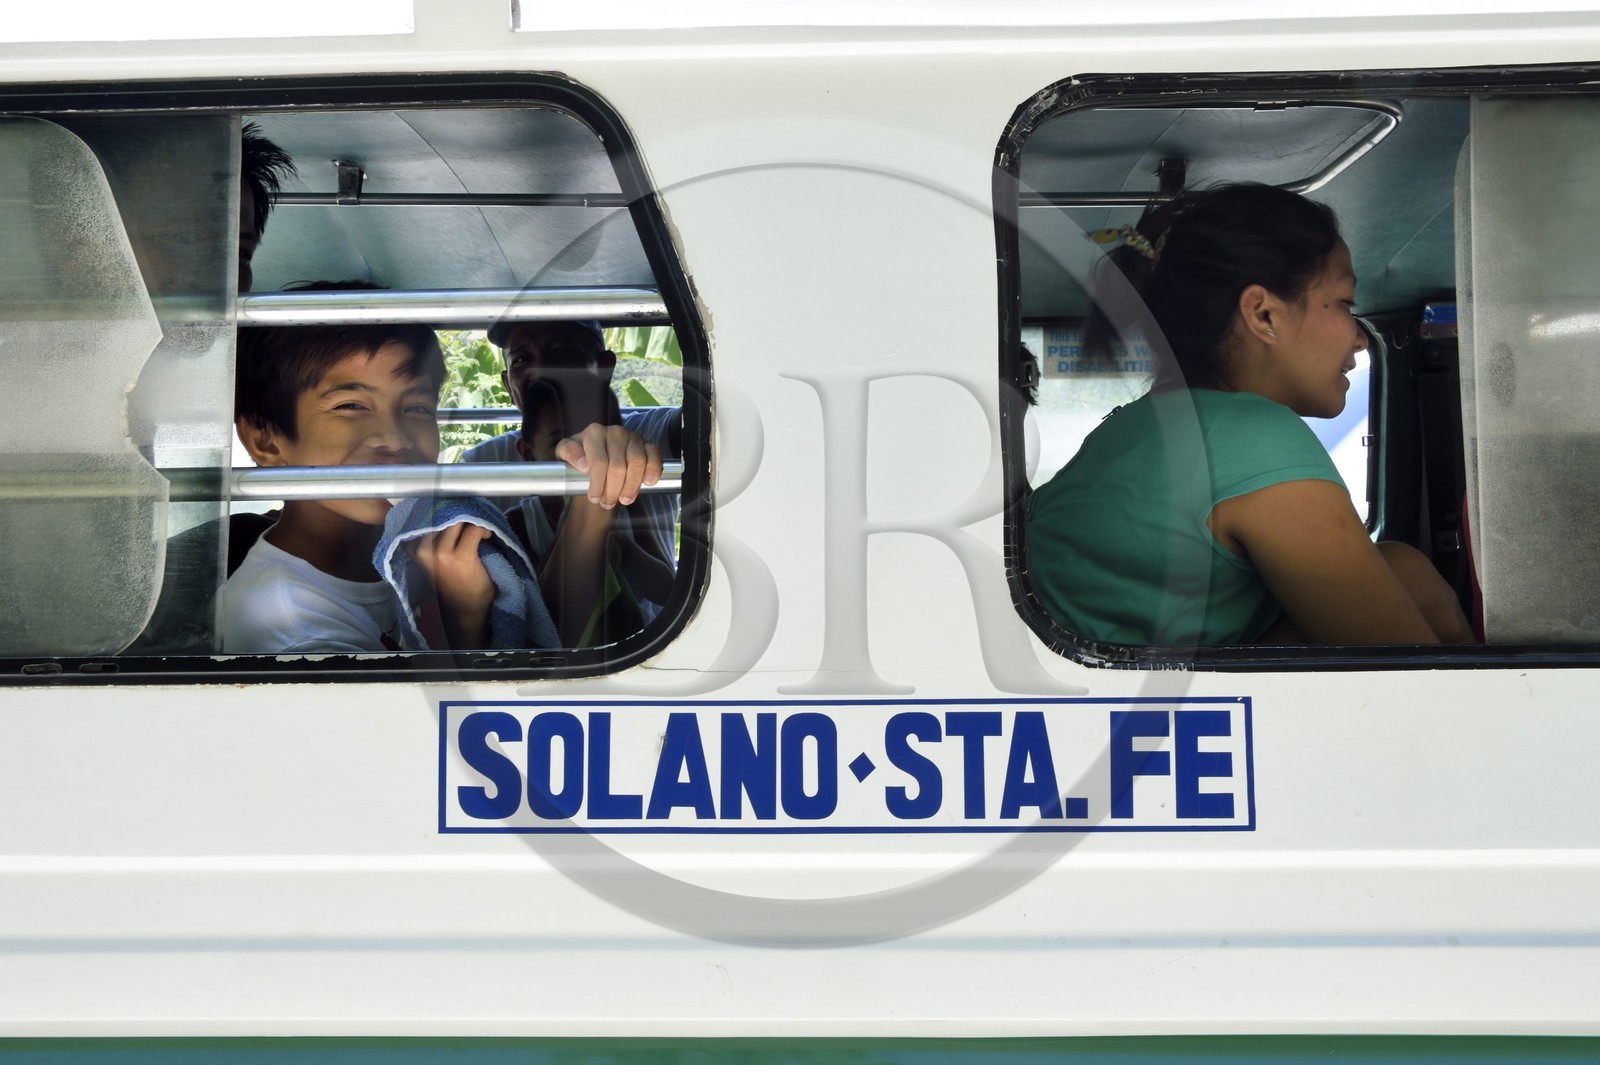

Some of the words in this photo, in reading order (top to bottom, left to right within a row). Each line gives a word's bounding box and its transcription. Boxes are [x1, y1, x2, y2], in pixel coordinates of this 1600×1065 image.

[1050, 331, 1071, 342] THIS
[1057, 360, 1152, 373] DISABILITIE
[458, 712, 837, 819] SOLANO
[885, 712, 1086, 819] STA.
[1110, 711, 1234, 818] FE
